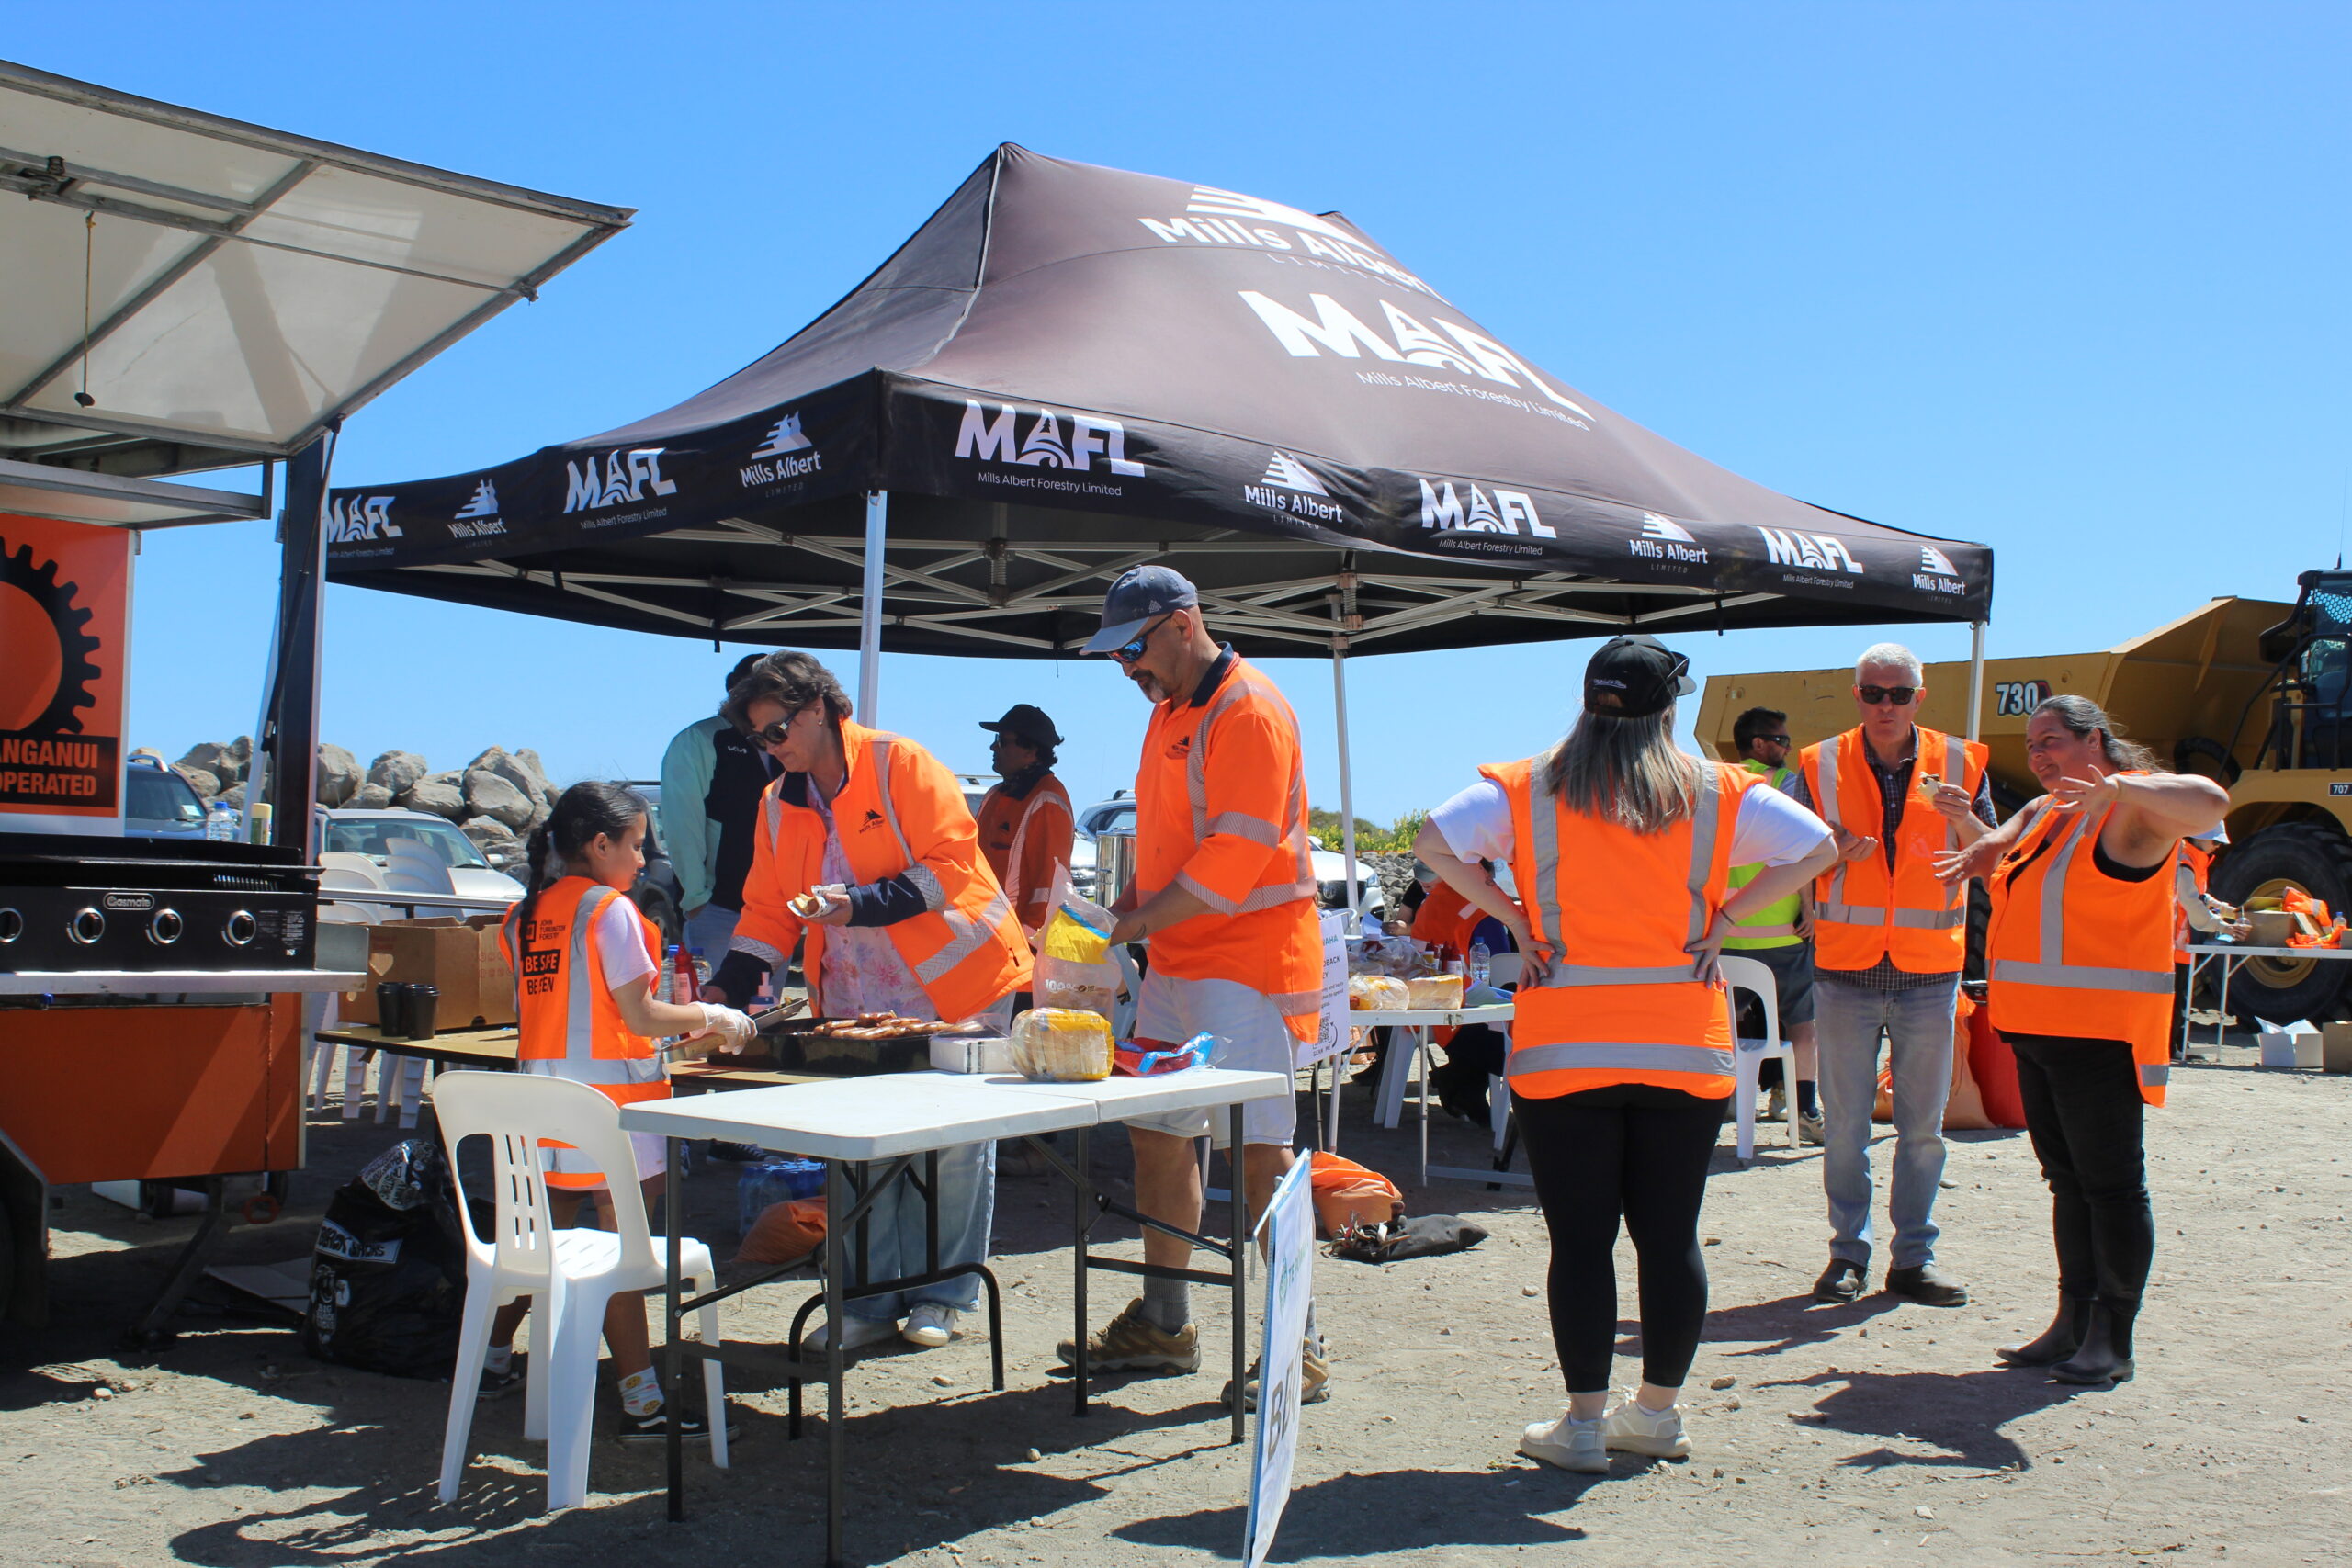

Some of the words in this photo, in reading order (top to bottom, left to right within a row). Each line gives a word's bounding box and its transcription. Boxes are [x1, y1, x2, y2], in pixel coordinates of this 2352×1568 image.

[1137, 217, 1292, 250] Mills
[1238, 290, 1597, 423] MAFL
[1355, 371, 1402, 388] Mills
[1404, 375, 1463, 396] Albert
[1461, 383, 1531, 412] Forestry
[1528, 400, 1591, 432] Limited
[954, 398, 1146, 478] MAFL
[562, 446, 678, 514] MAFL
[739, 461, 775, 488] Mills
[776, 450, 822, 480] Albert
[978, 471, 1001, 485] Mills
[1001, 474, 1035, 489] Albert
[1037, 478, 1080, 494] Forestry
[1082, 481, 1122, 496] Limited
[1244, 484, 1287, 511] Mills
[1290, 494, 1343, 523] Albert
[1419, 478, 1557, 539] MAFL
[1439, 538, 1456, 549] Mills
[1457, 539, 1482, 551] Albert
[1482, 541, 1513, 555] Forestry
[1514, 544, 1544, 556] Limited
[1629, 538, 1664, 558] Mills
[1667, 543, 1708, 564] Albert
[1756, 525, 1864, 574] MAFL
[1650, 563, 1689, 574] LIMITED
[1912, 573, 1936, 591] Mills
[1938, 577, 1966, 596] Albert
[1996, 682, 2039, 715] 730
[0, 738, 98, 769] NGANUI
[0, 770, 97, 796] PERATED
[2333, 784, 2349, 795] 707
[525, 956, 539, 973] BE
[526, 979, 538, 996] BE
